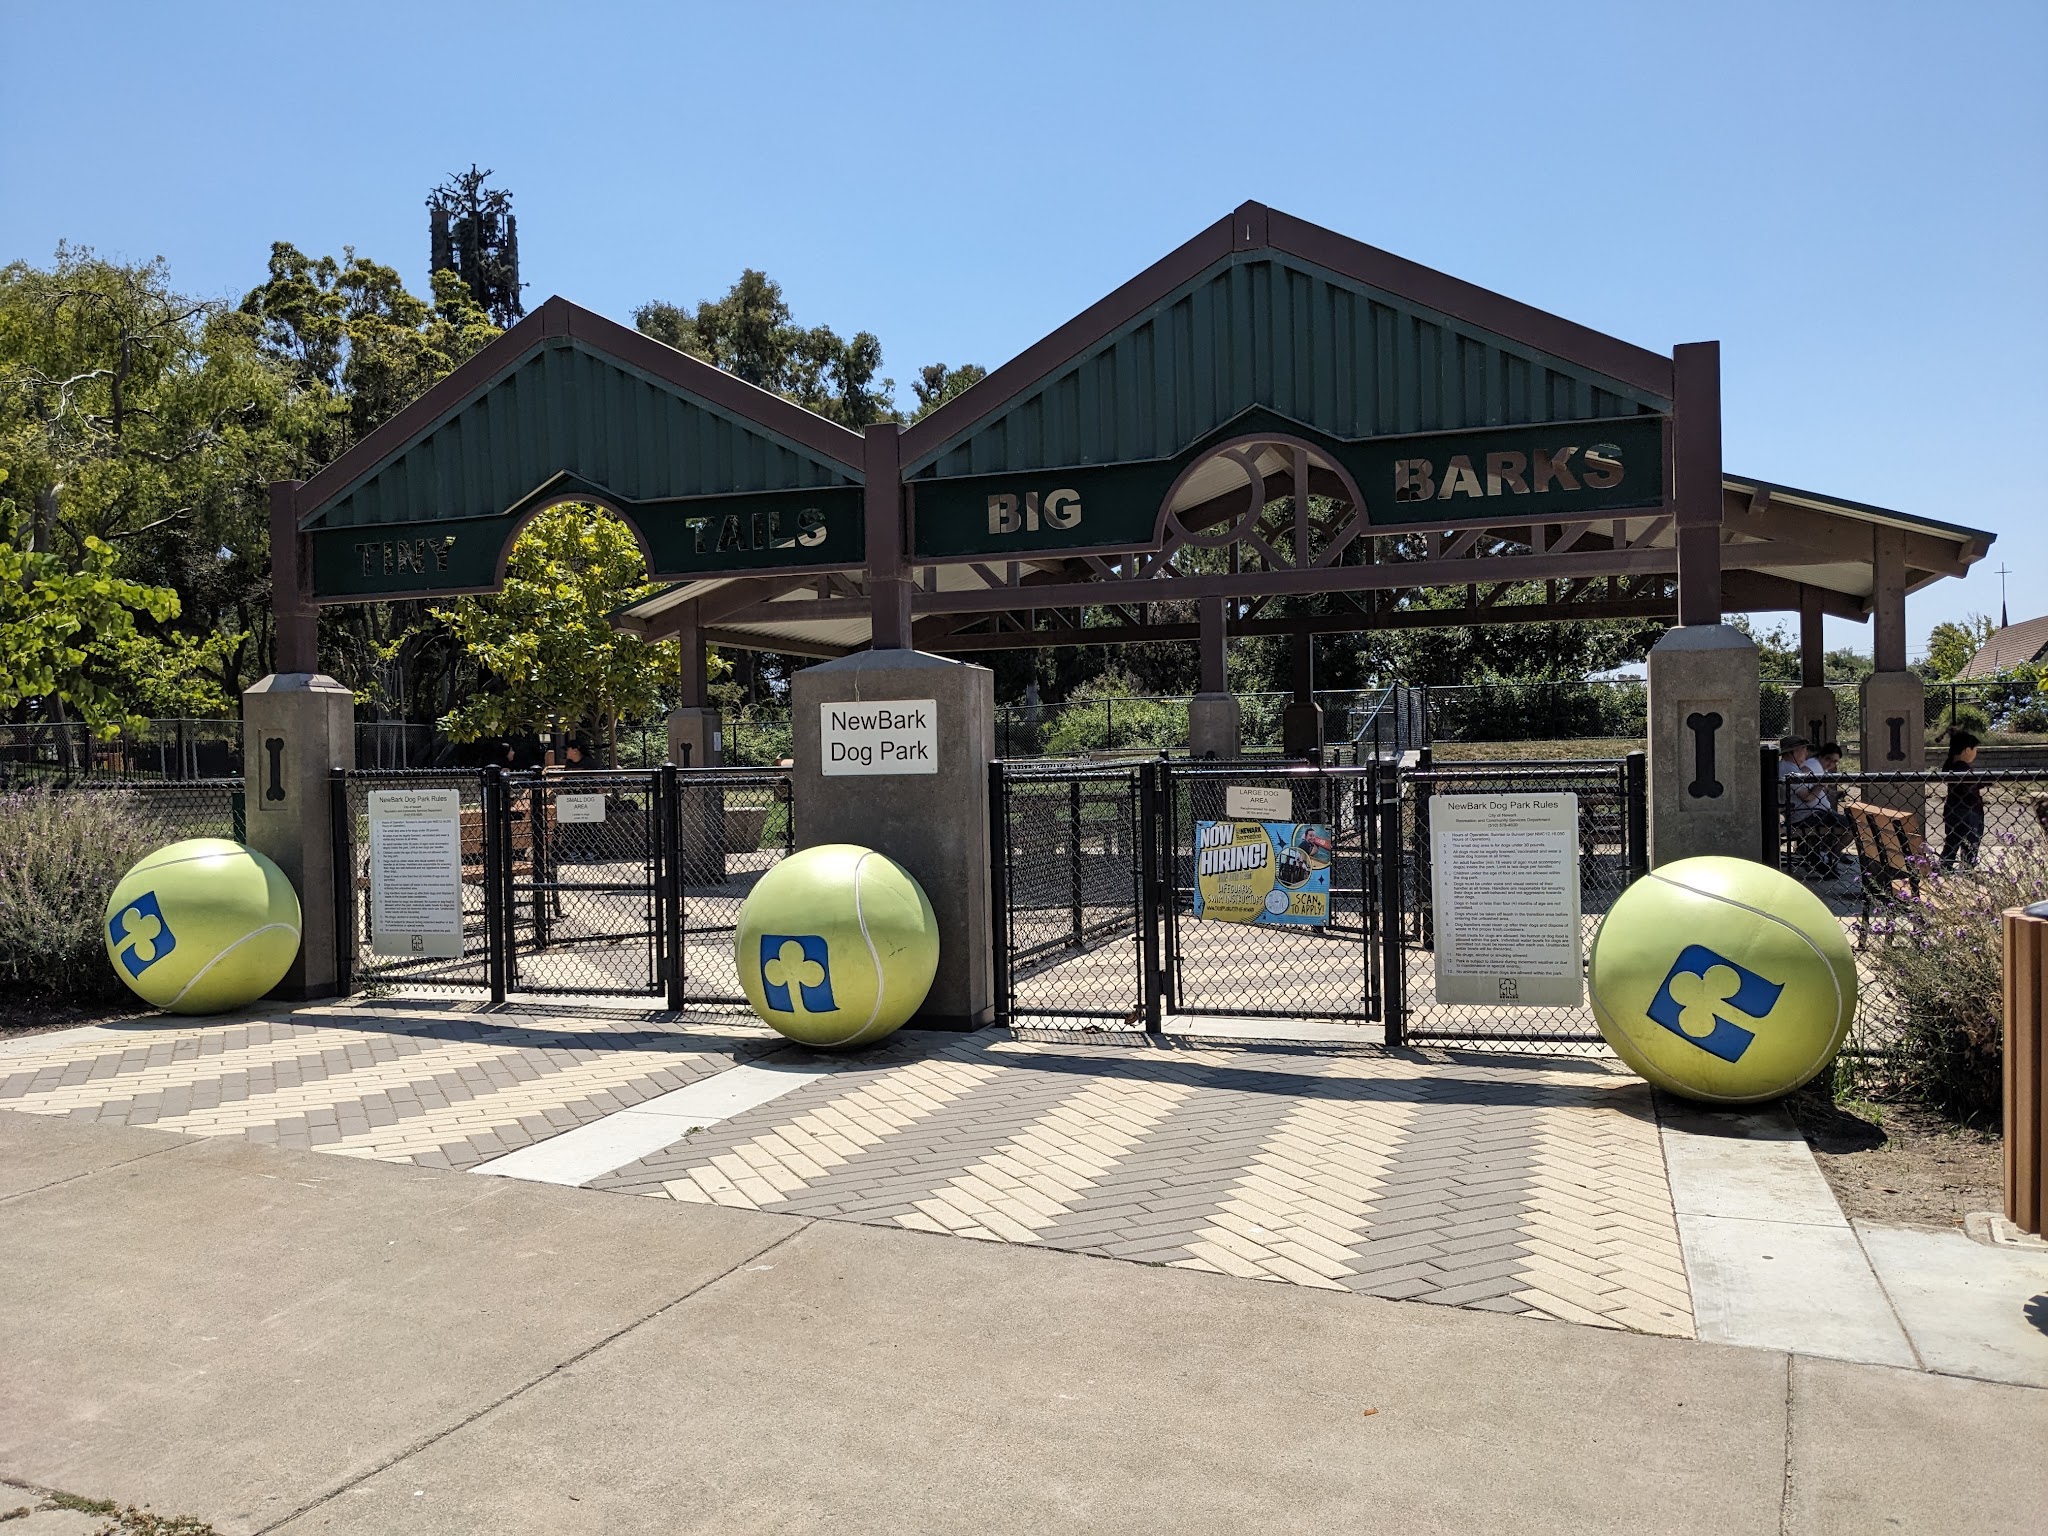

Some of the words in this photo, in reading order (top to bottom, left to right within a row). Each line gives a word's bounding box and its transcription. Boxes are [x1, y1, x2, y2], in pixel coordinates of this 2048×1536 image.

[988, 489, 1082, 534] BIG
[1395, 443, 1624, 502] BARKS
[355, 537, 456, 576] TINY
[685, 508, 827, 553] TAILS
[832, 710, 926, 730] NewBark
[832, 742, 872, 766] Dog
[881, 740, 928, 760] Park
[1490, 802, 1507, 811] Dog
[1533, 801, 1559, 809] Rules
[1200, 824, 1234, 849] NOW
[1200, 842, 1268, 876] HIRING!
[1218, 884, 1253, 894] LIFEGUARDS
[1296, 894, 1318, 904] SCAN
[1290, 904, 1298, 914] TO
[1301, 904, 1325, 915] APPLY!
